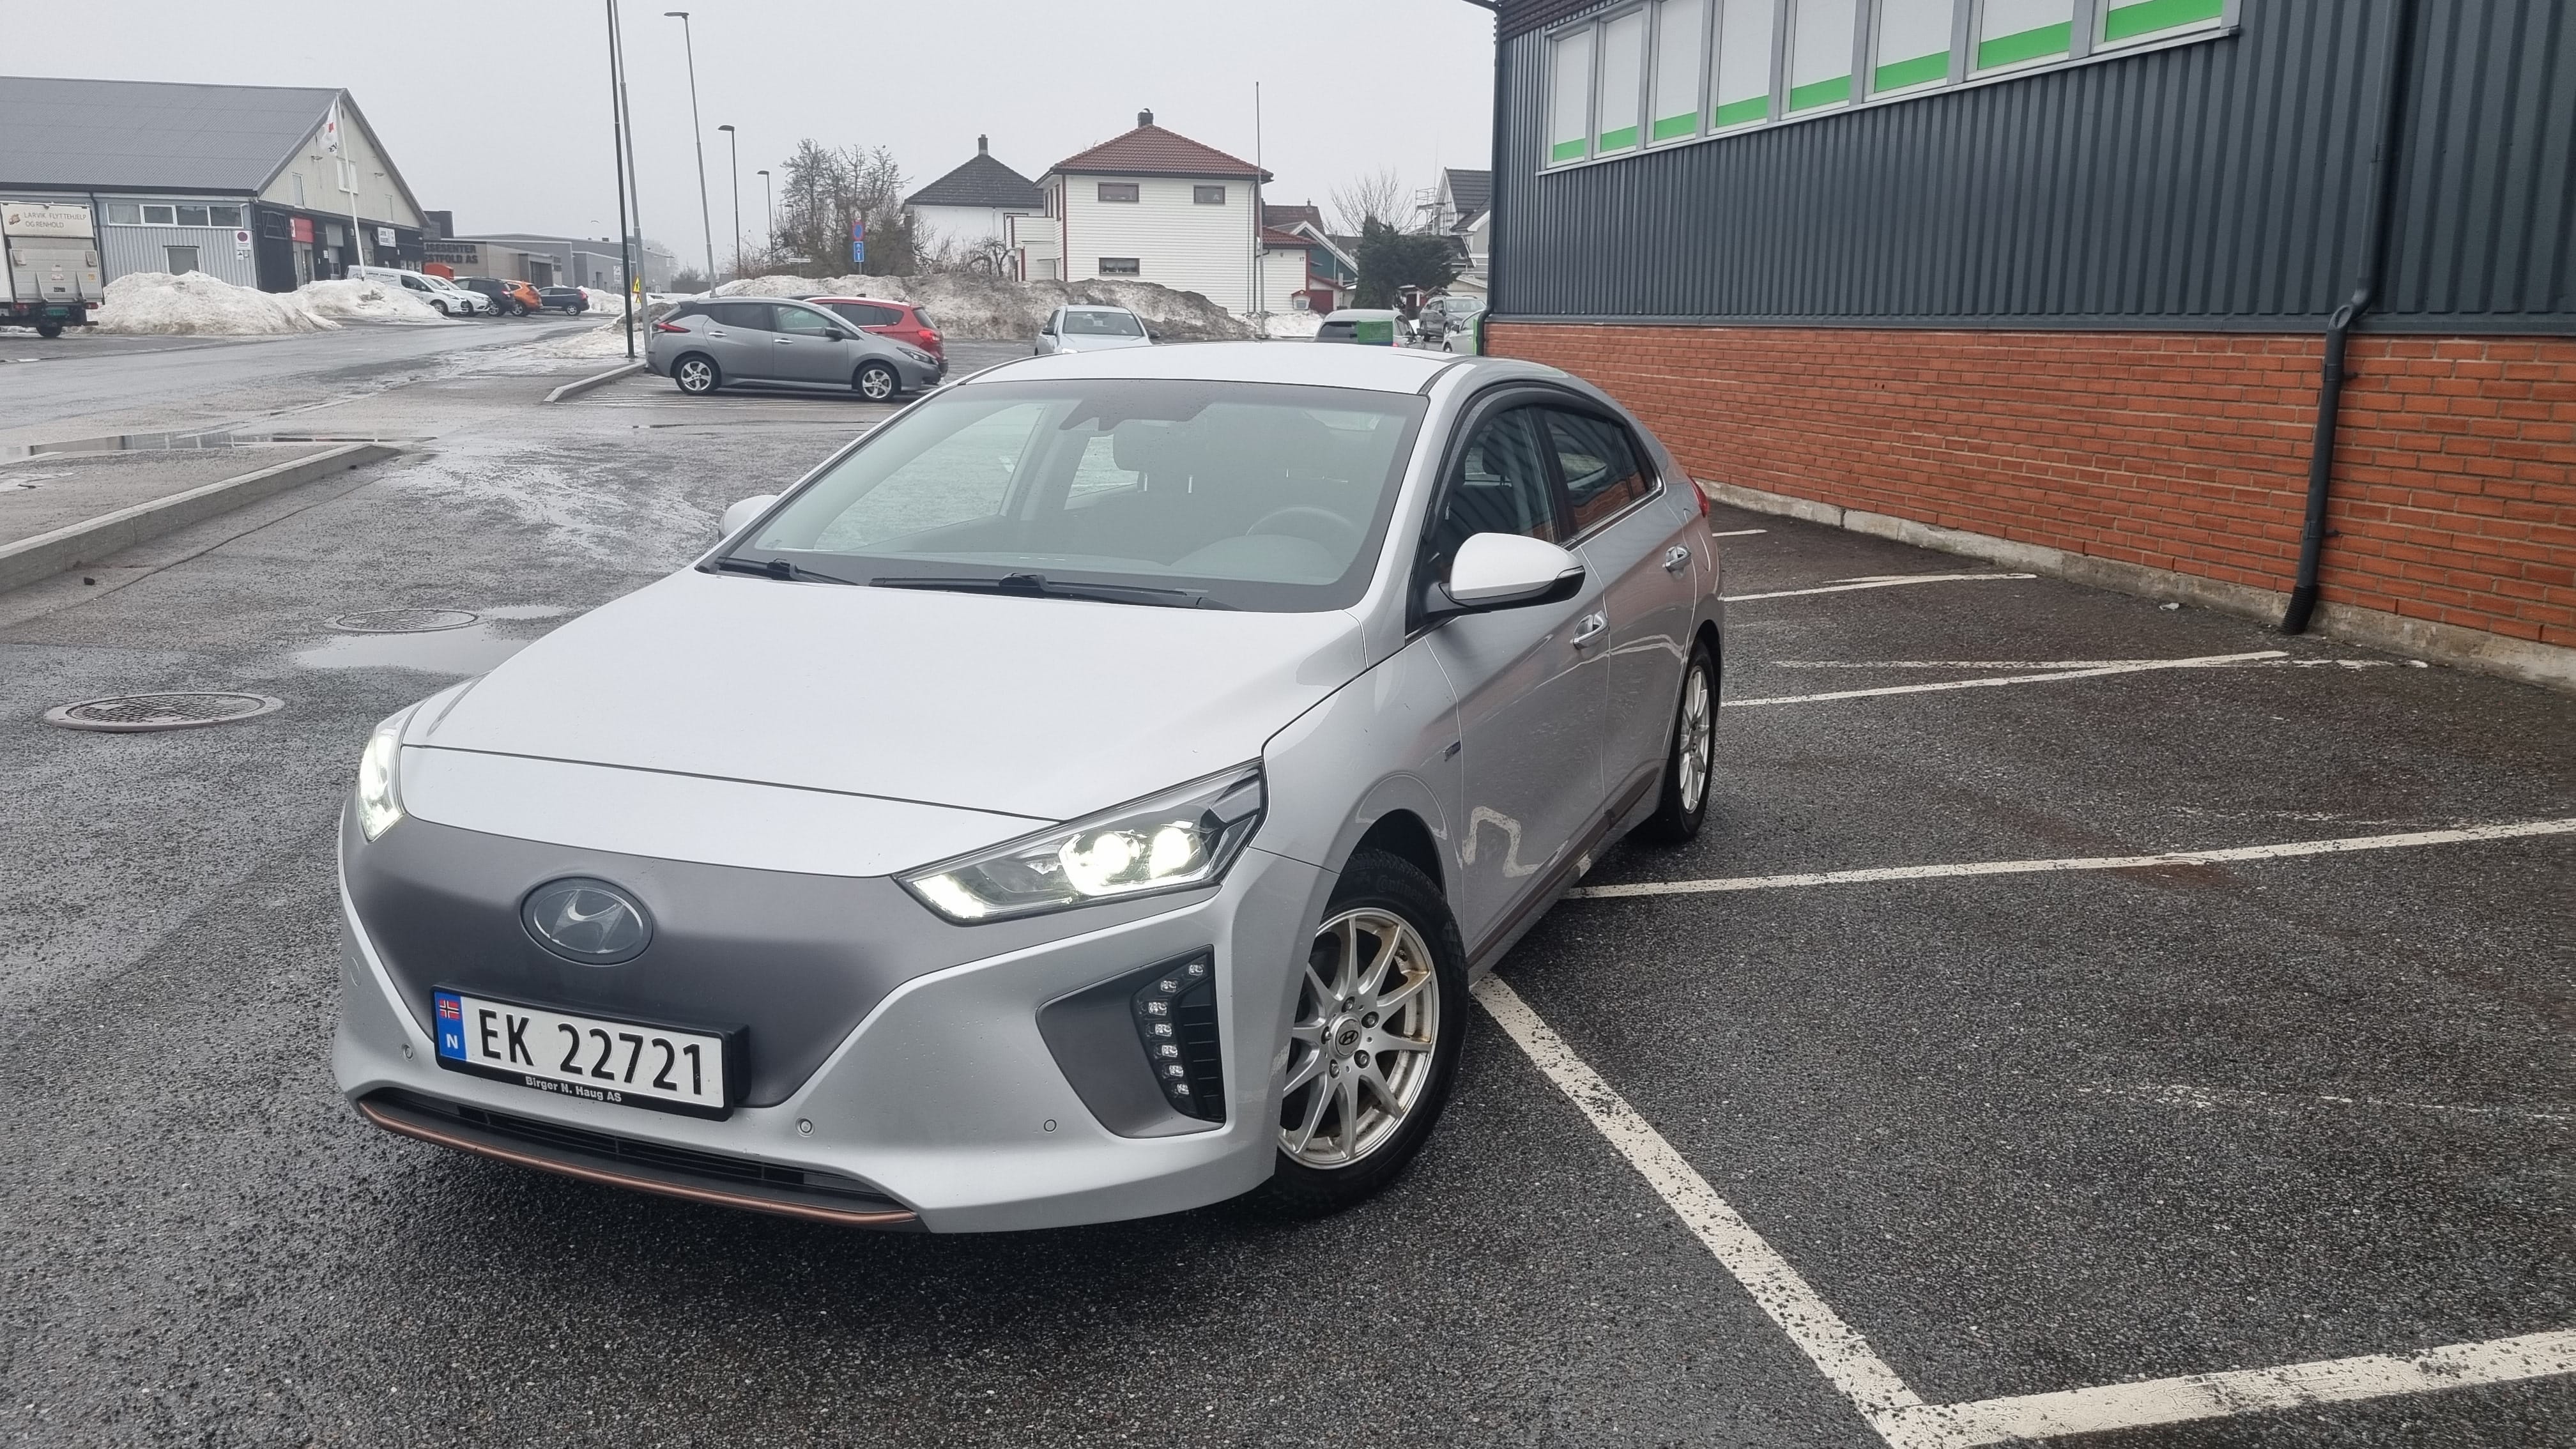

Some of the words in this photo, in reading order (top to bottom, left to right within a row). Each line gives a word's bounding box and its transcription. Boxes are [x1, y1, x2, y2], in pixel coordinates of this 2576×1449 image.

[465, 254, 478, 264] AS
[446, 1033, 458, 1049] N
[479, 1008, 534, 1066] EK
[558, 1023, 702, 1095] 22721
[525, 1076, 558, 1091] Birger
[560, 1082, 572, 1094] N.
[576, 1085, 603, 1100] Haug
[607, 1091, 622, 1102] AS
